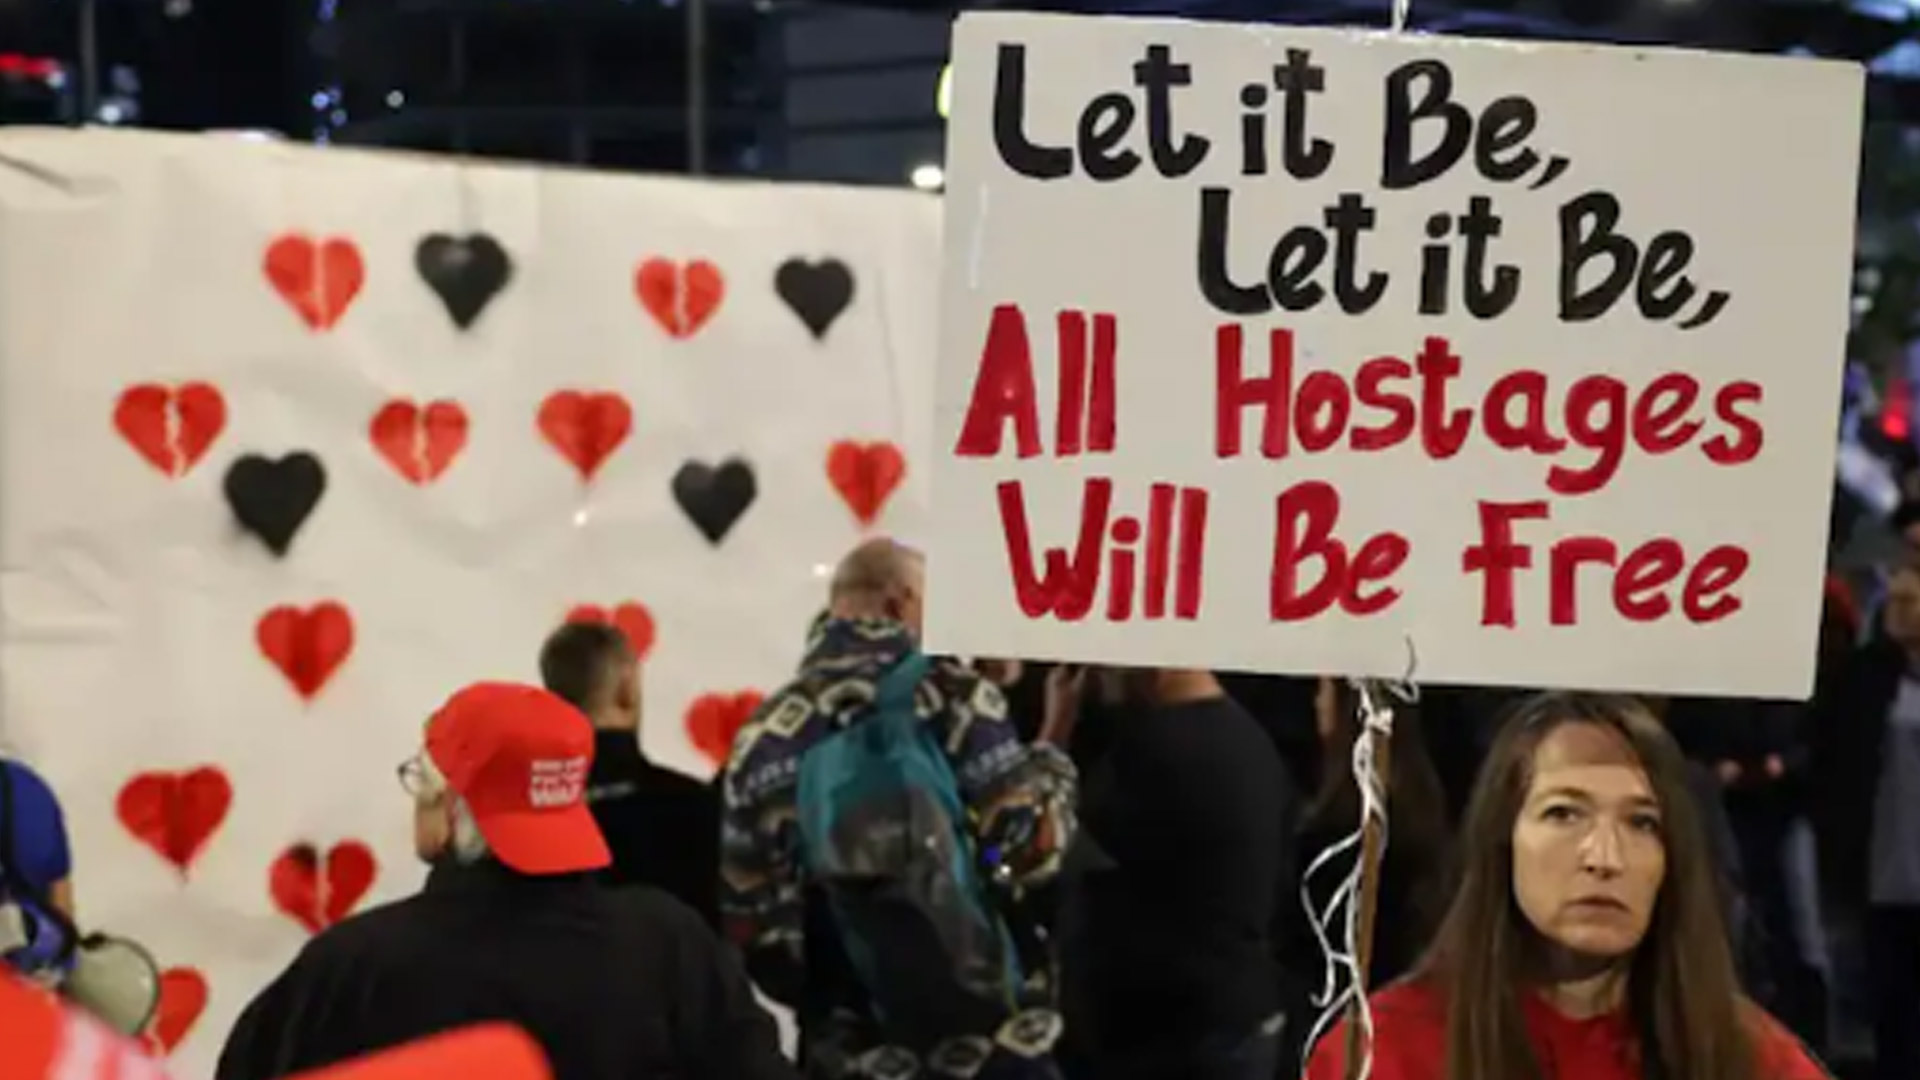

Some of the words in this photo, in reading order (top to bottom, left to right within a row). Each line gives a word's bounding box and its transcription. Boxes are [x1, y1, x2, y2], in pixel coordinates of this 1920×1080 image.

[993, 44, 1210, 181] Let
[1241, 48, 1334, 180] it
[1381, 60, 1569, 189] Be,
[1198, 187, 1389, 315] Let
[1419, 196, 1520, 319] it
[1558, 191, 1730, 329] Be,
[955, 304, 1116, 459] All
[1216, 323, 1763, 494] Hostages
[997, 478, 1208, 621] Will
[1270, 481, 1409, 621] Be
